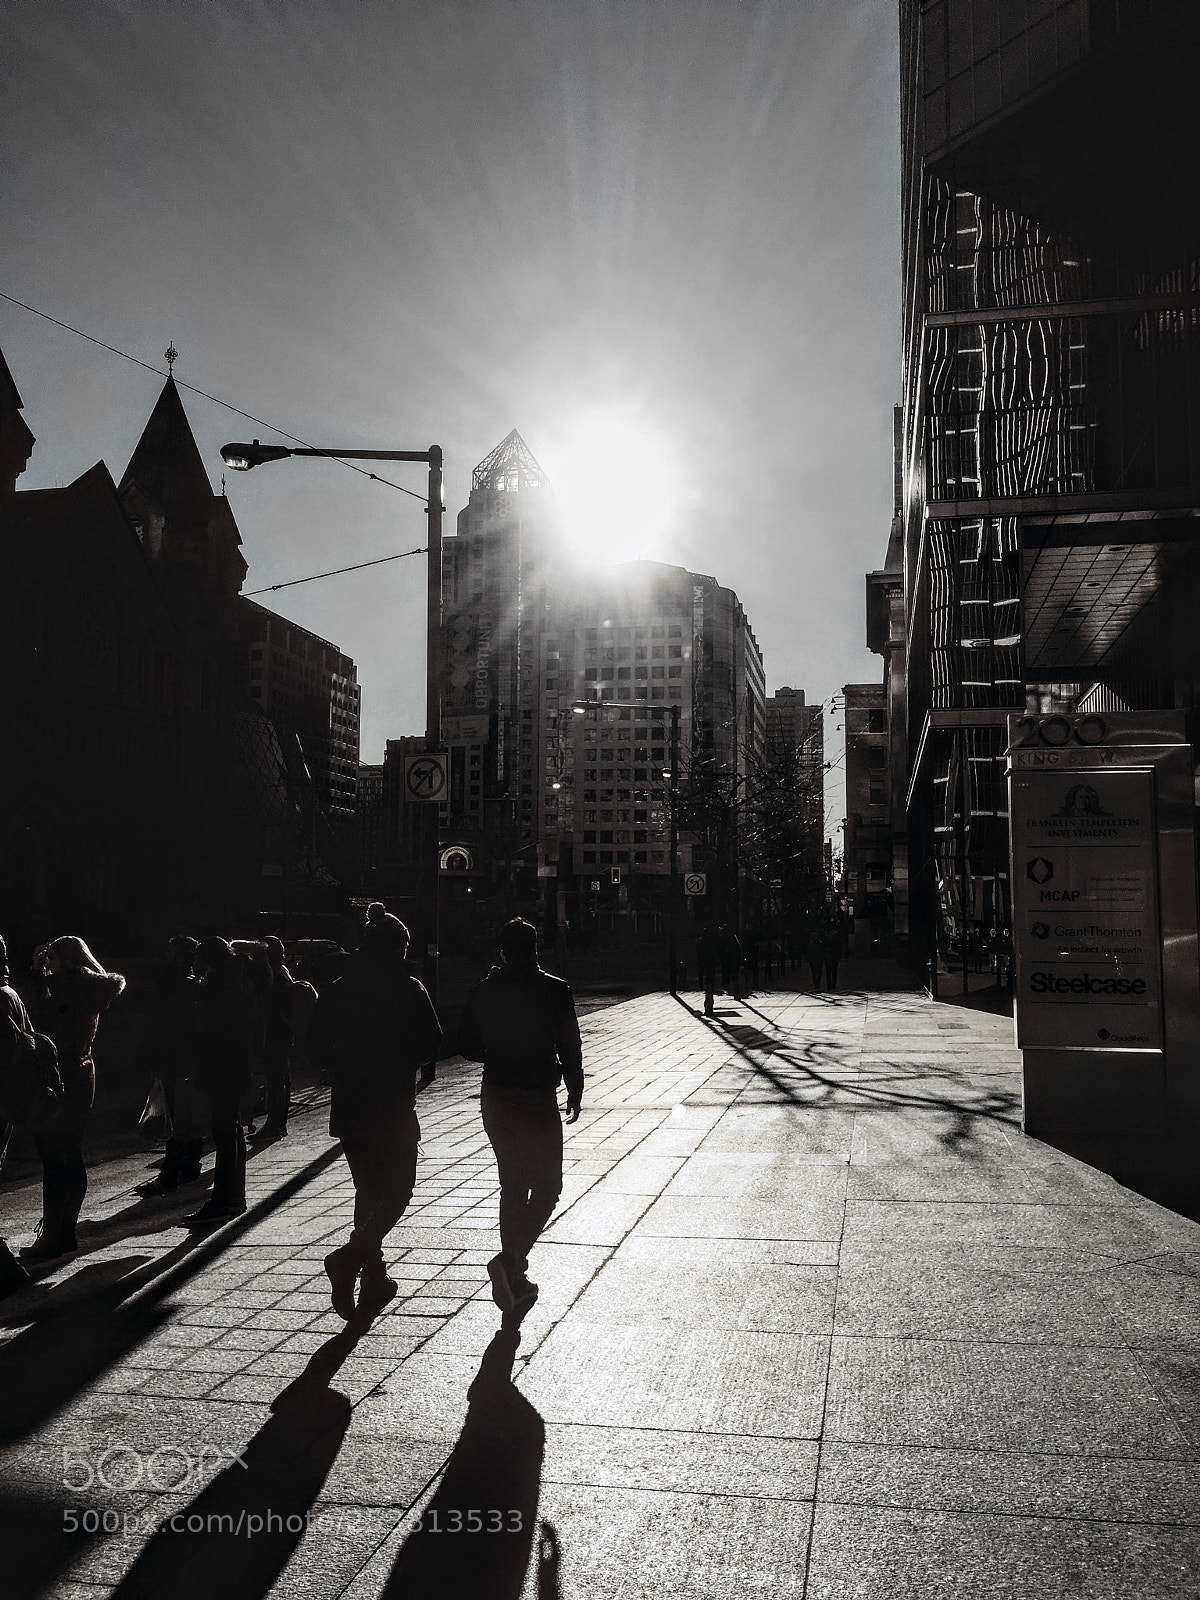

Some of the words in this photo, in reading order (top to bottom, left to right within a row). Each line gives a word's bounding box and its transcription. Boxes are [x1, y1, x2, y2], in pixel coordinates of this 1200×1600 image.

[1017, 715, 1107, 747] 200
[1018, 753, 1059, 766] KING
[1026, 818, 1076, 828] FRANKLIN
[1080, 817, 1140, 827] TEMPLETON
[1048, 829, 1119, 837] INVESTMENTS
[1040, 890, 1080, 902] MCAP
[1055, 926, 1088, 937] Grant
[1090, 926, 1141, 938] Thornton
[1030, 972, 1147, 995] Steelcase
